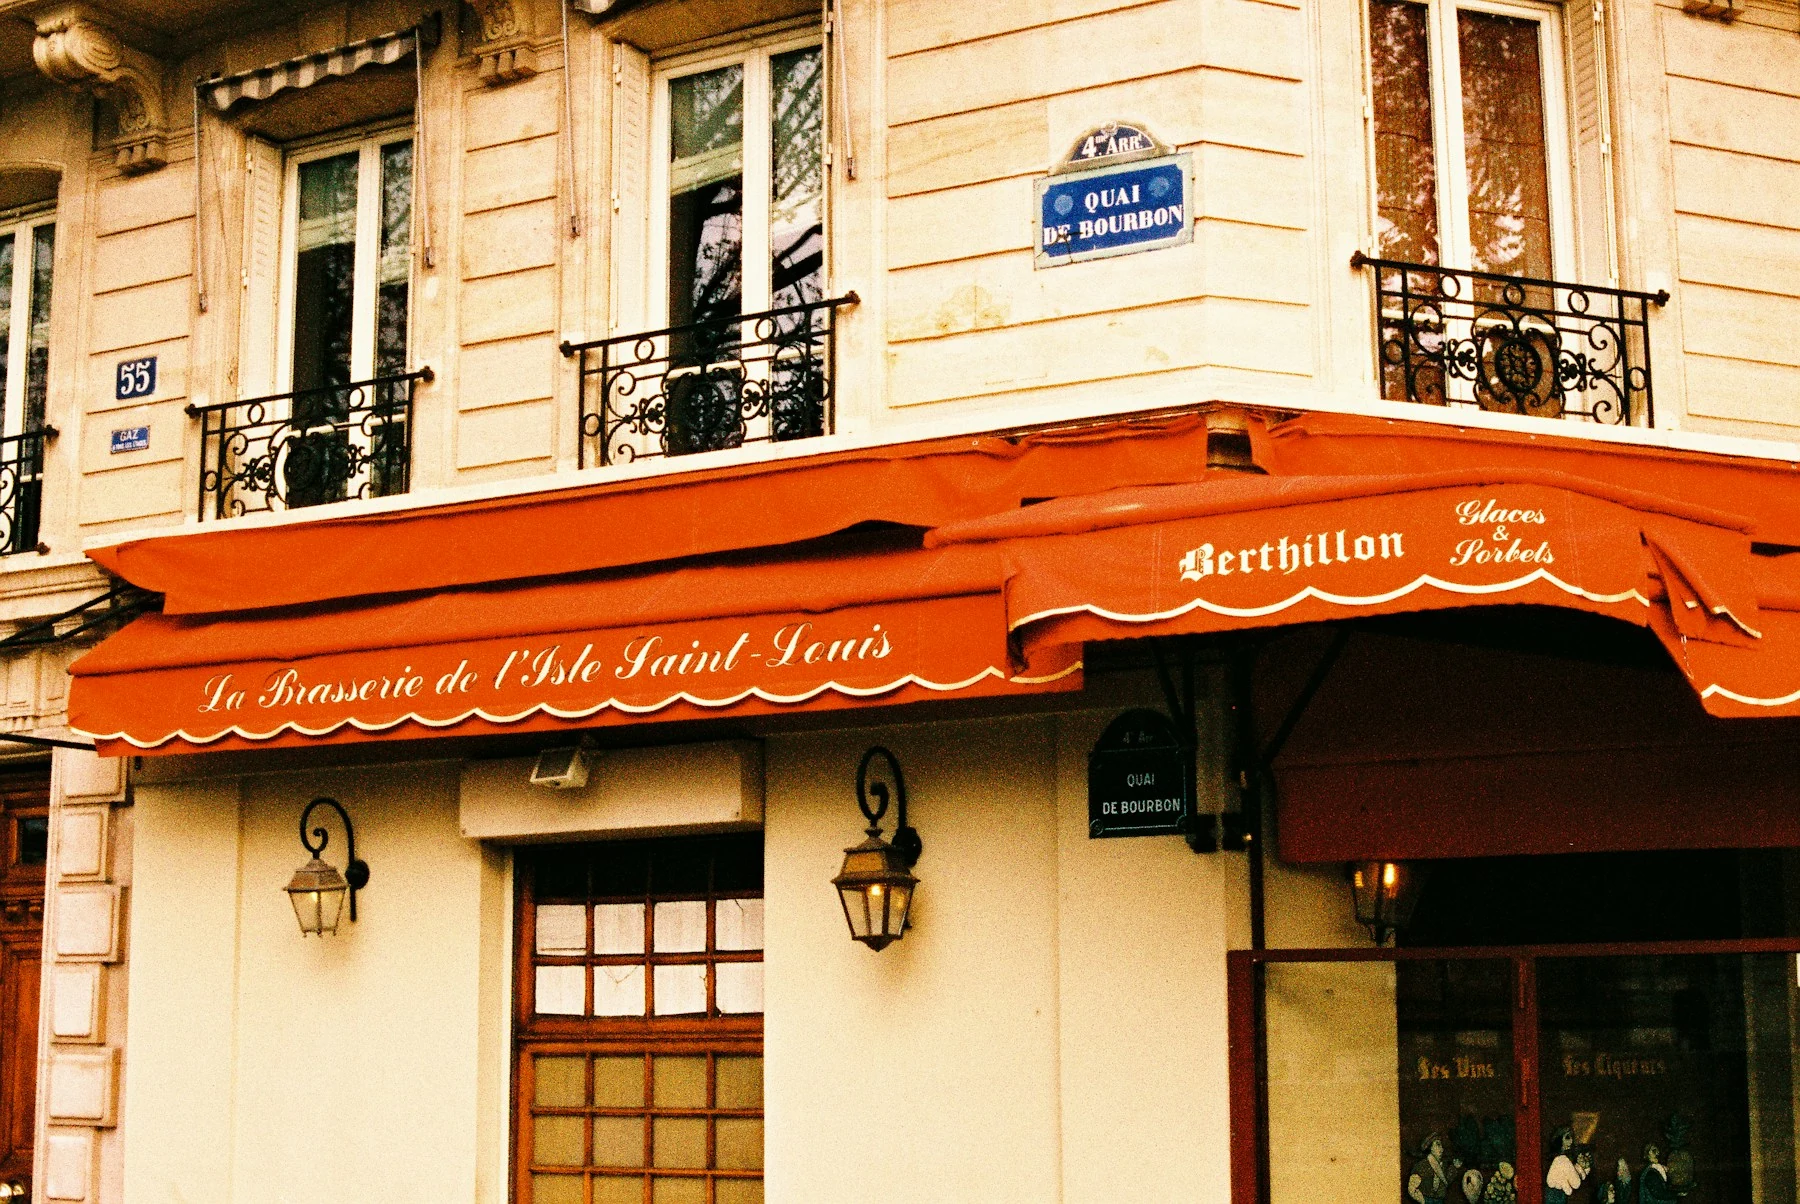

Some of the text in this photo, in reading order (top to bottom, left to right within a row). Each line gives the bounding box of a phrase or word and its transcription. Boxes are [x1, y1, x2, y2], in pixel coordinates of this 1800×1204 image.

[1084, 184, 1140, 213] QUAI
[1043, 204, 1183, 245] DE BOURBON
[120, 360, 151, 395] 55
[120, 430, 139, 441] GAZ
[1455, 499, 1546, 525] Glaces
[1492, 525, 1510, 541] &
[1179, 529, 1405, 583] Berthillon
[1449, 538, 1554, 565] Sorbets
[198, 673, 246, 713] La
[258, 665, 424, 708] Brasserie
[435, 659, 478, 694] de
[1126, 772, 1155, 787] QUAI
[1102, 798, 1181, 815] DE BOURBON
